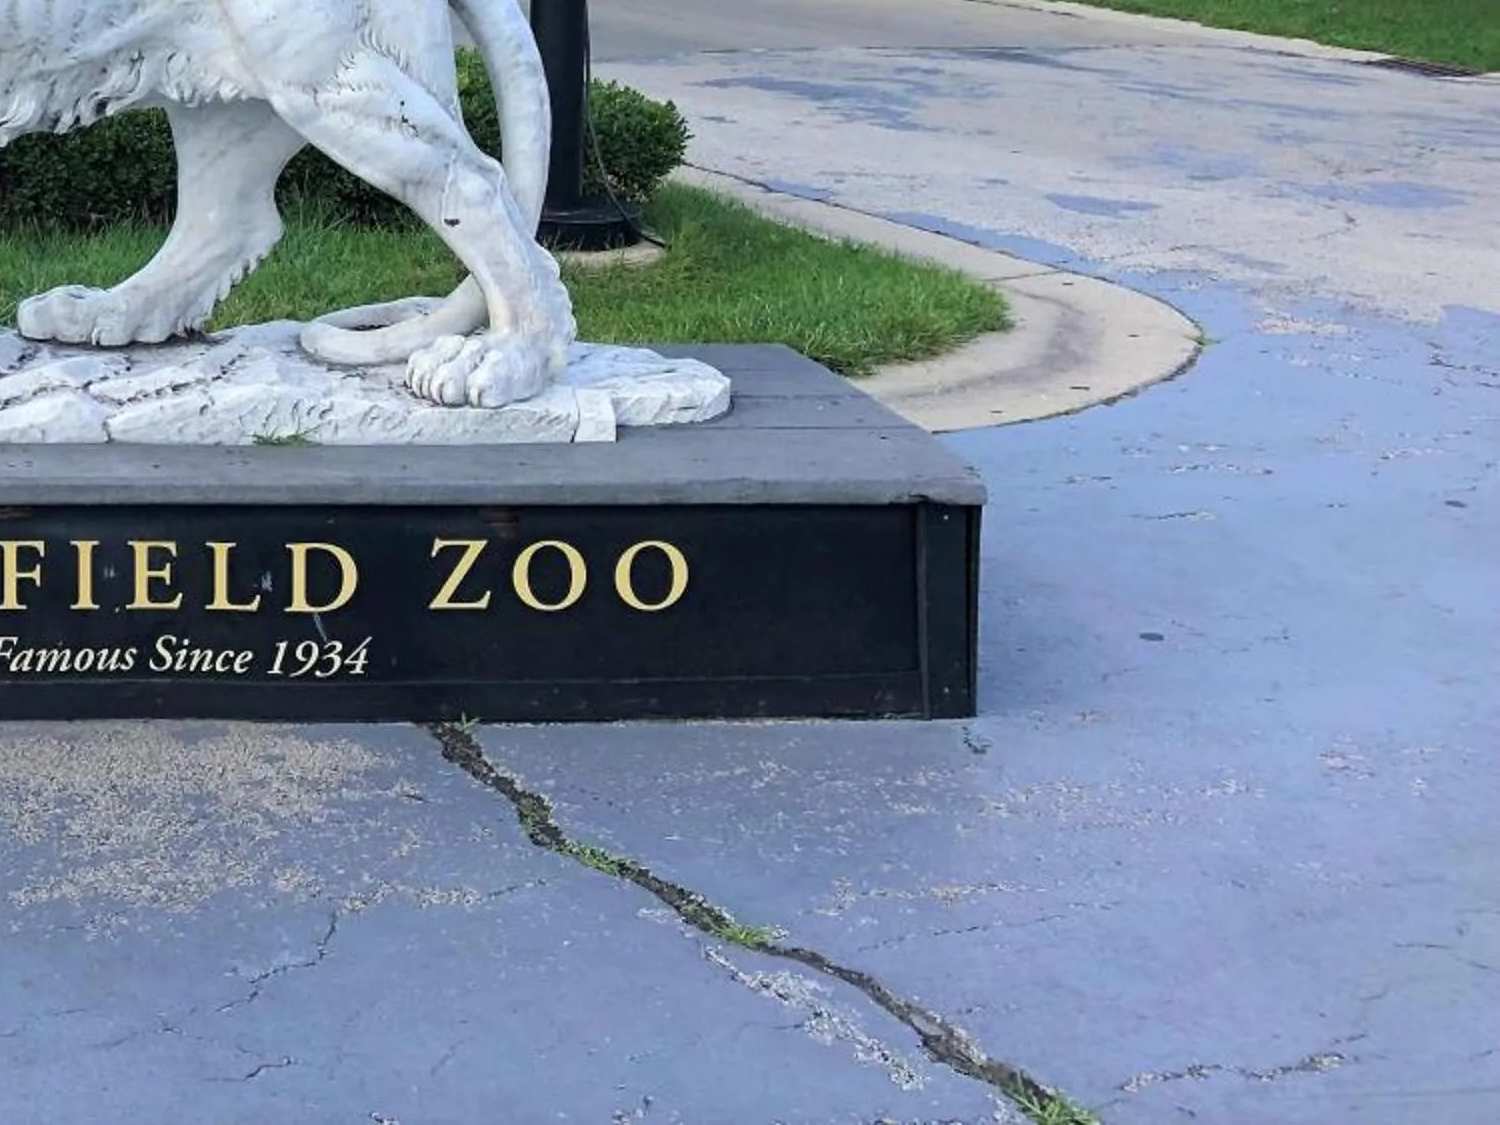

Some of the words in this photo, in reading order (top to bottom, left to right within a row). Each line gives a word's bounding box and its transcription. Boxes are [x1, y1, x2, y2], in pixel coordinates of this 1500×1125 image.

[428, 539, 690, 612] ZOO
[149, 634, 254, 674] Since
[266, 635, 373, 678] 1934
